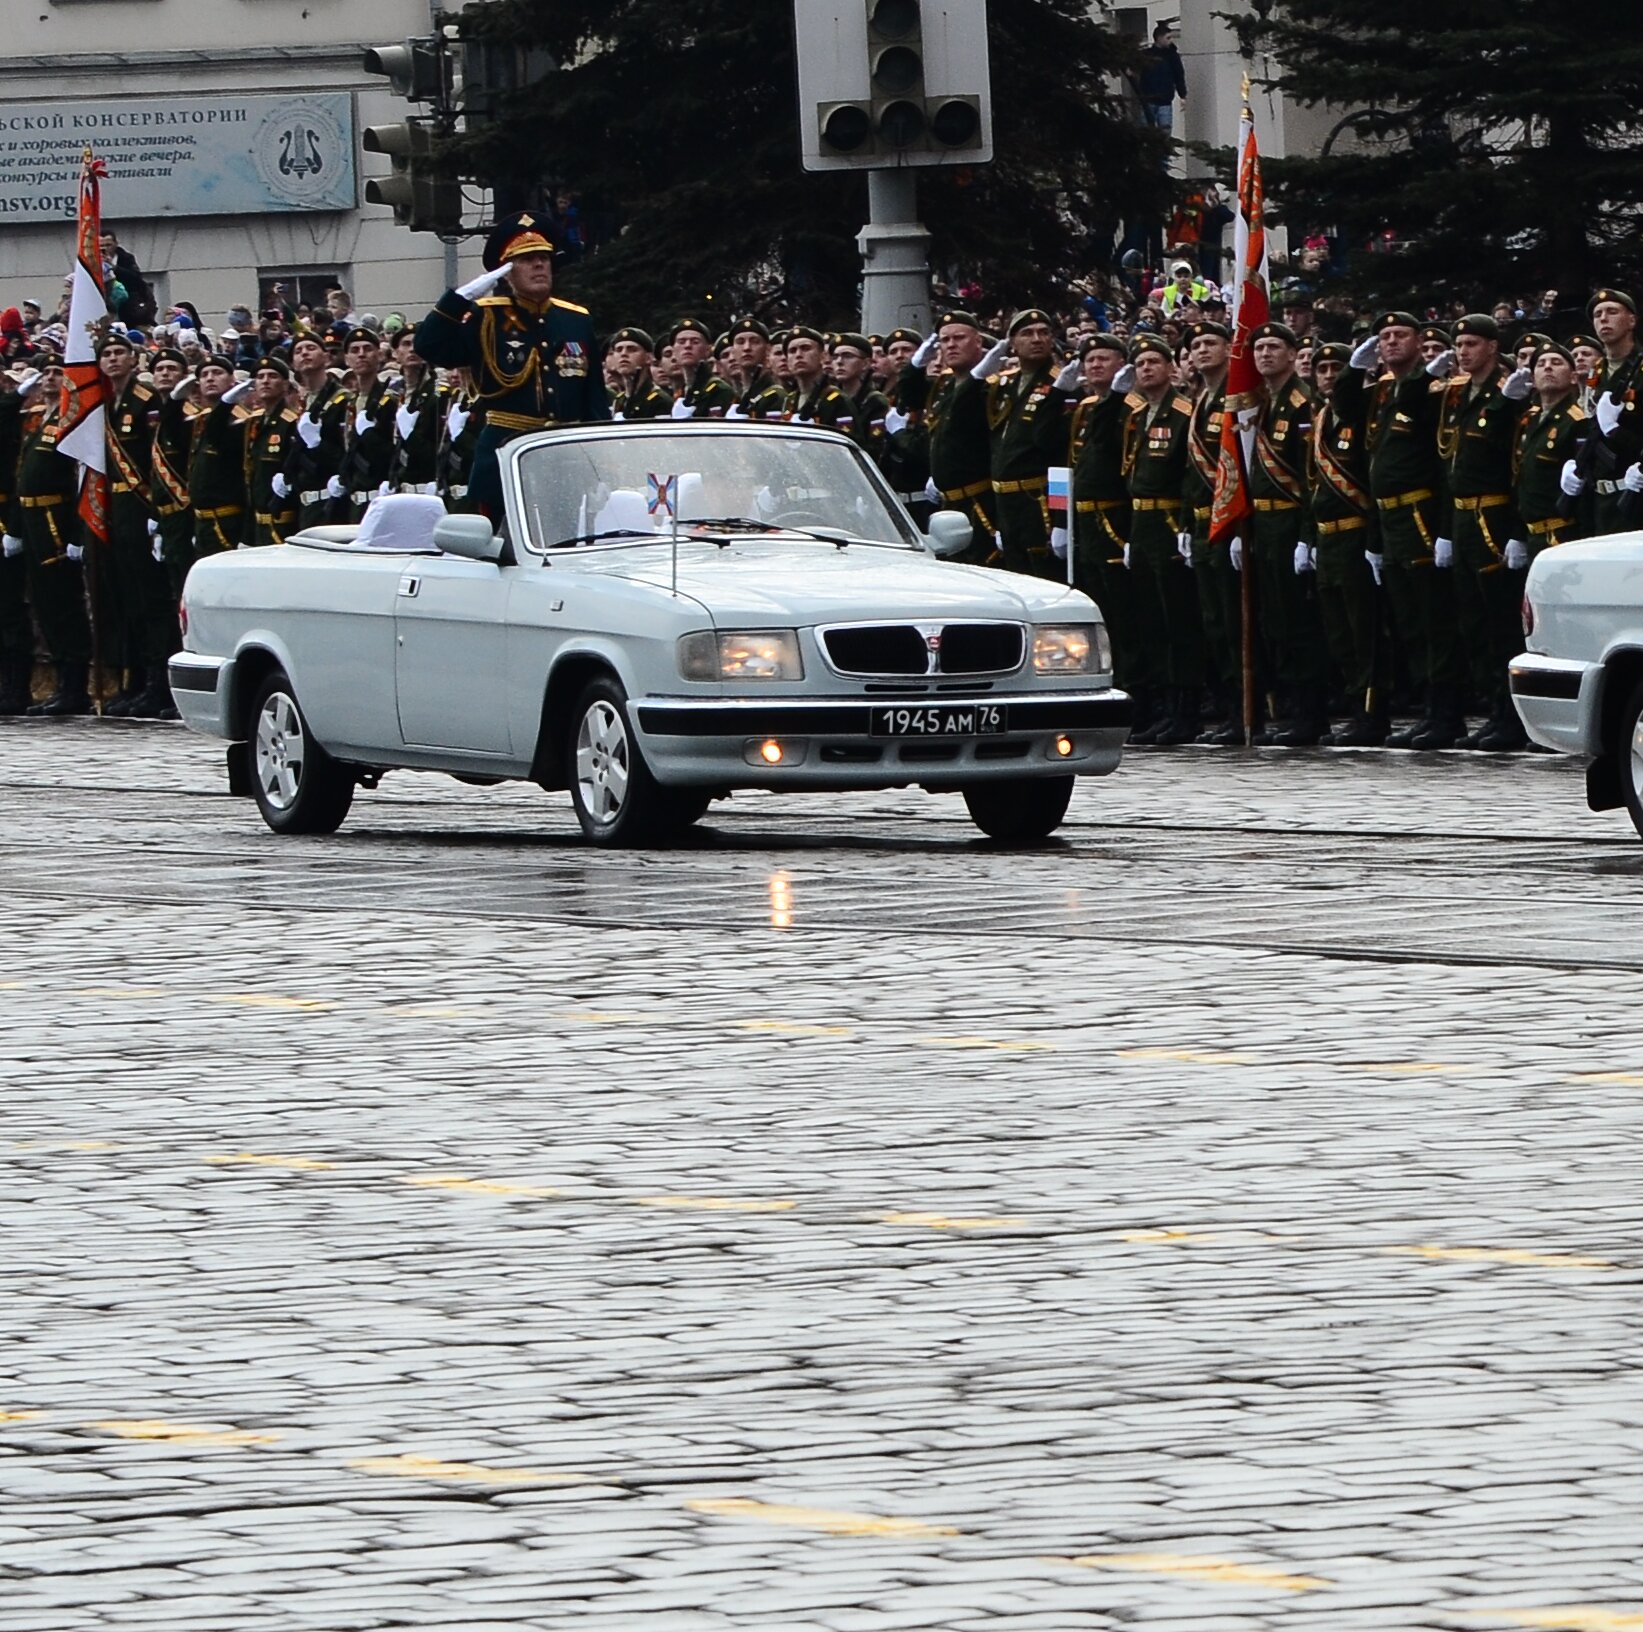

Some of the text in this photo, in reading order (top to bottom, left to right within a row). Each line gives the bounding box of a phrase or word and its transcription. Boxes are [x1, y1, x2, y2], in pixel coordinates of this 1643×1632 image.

[73, 109, 247, 127] КОНСЕРВАТОРИИ
[18, 153, 137, 167] академиеские
[883, 709, 940, 733] 1945
[980, 707, 1000, 724] 76
